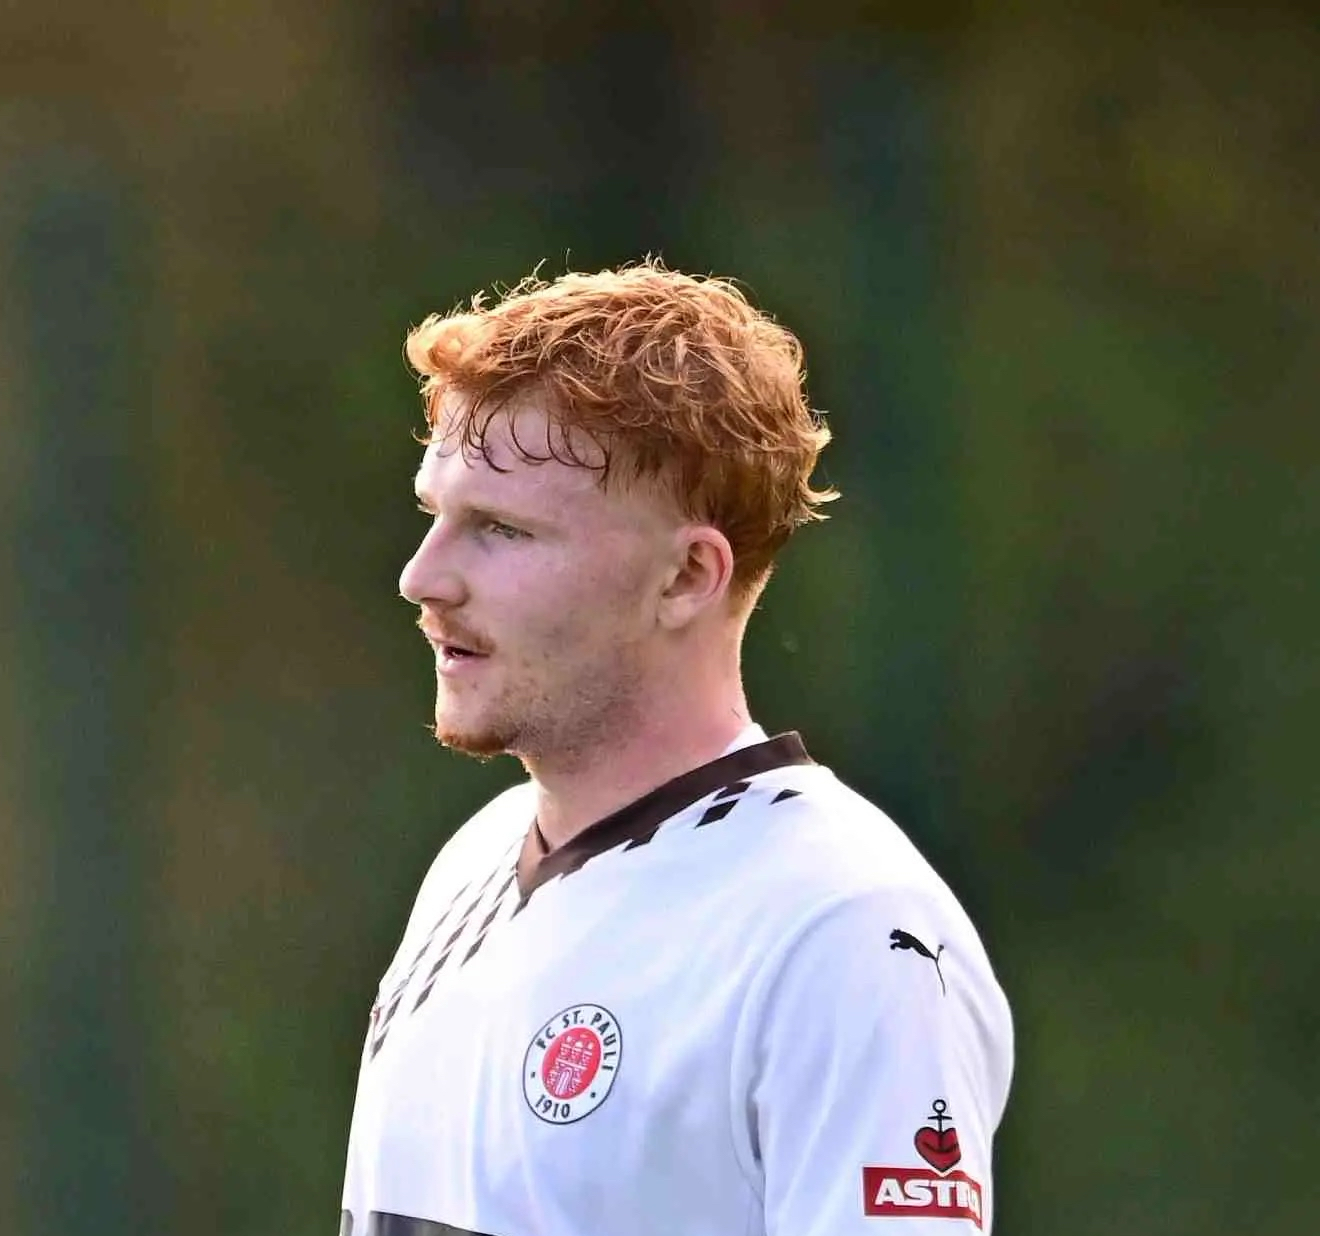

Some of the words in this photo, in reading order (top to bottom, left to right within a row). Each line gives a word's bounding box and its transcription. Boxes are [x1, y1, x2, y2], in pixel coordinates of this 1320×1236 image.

[535, 1027, 557, 1050] FC
[562, 1010, 584, 1029] ST.
[591, 1012, 617, 1072] PAULI
[535, 1094, 571, 1119] 1910
